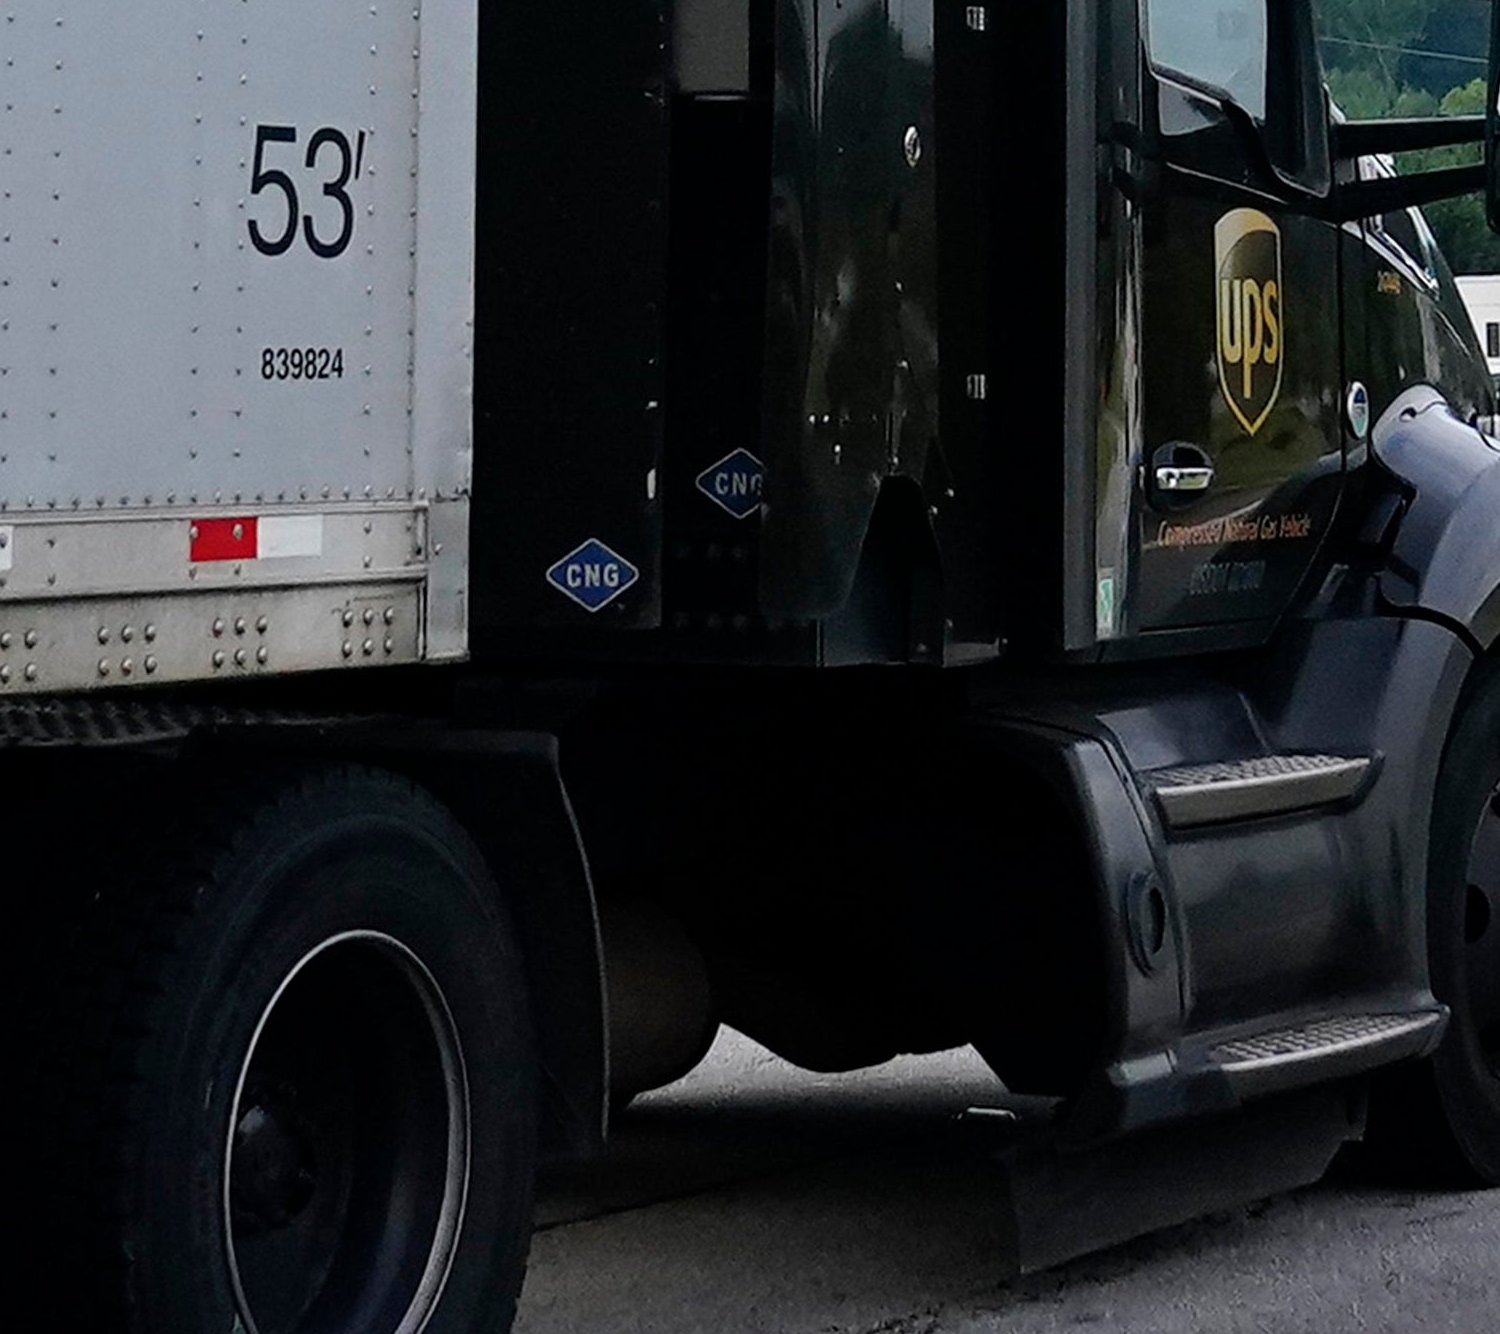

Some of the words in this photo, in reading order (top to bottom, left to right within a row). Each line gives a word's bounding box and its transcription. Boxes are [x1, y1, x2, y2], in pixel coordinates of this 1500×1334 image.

[1221, 278, 1278, 399] ups
[261, 347, 345, 380] 839824
[566, 563, 620, 589] CNG
